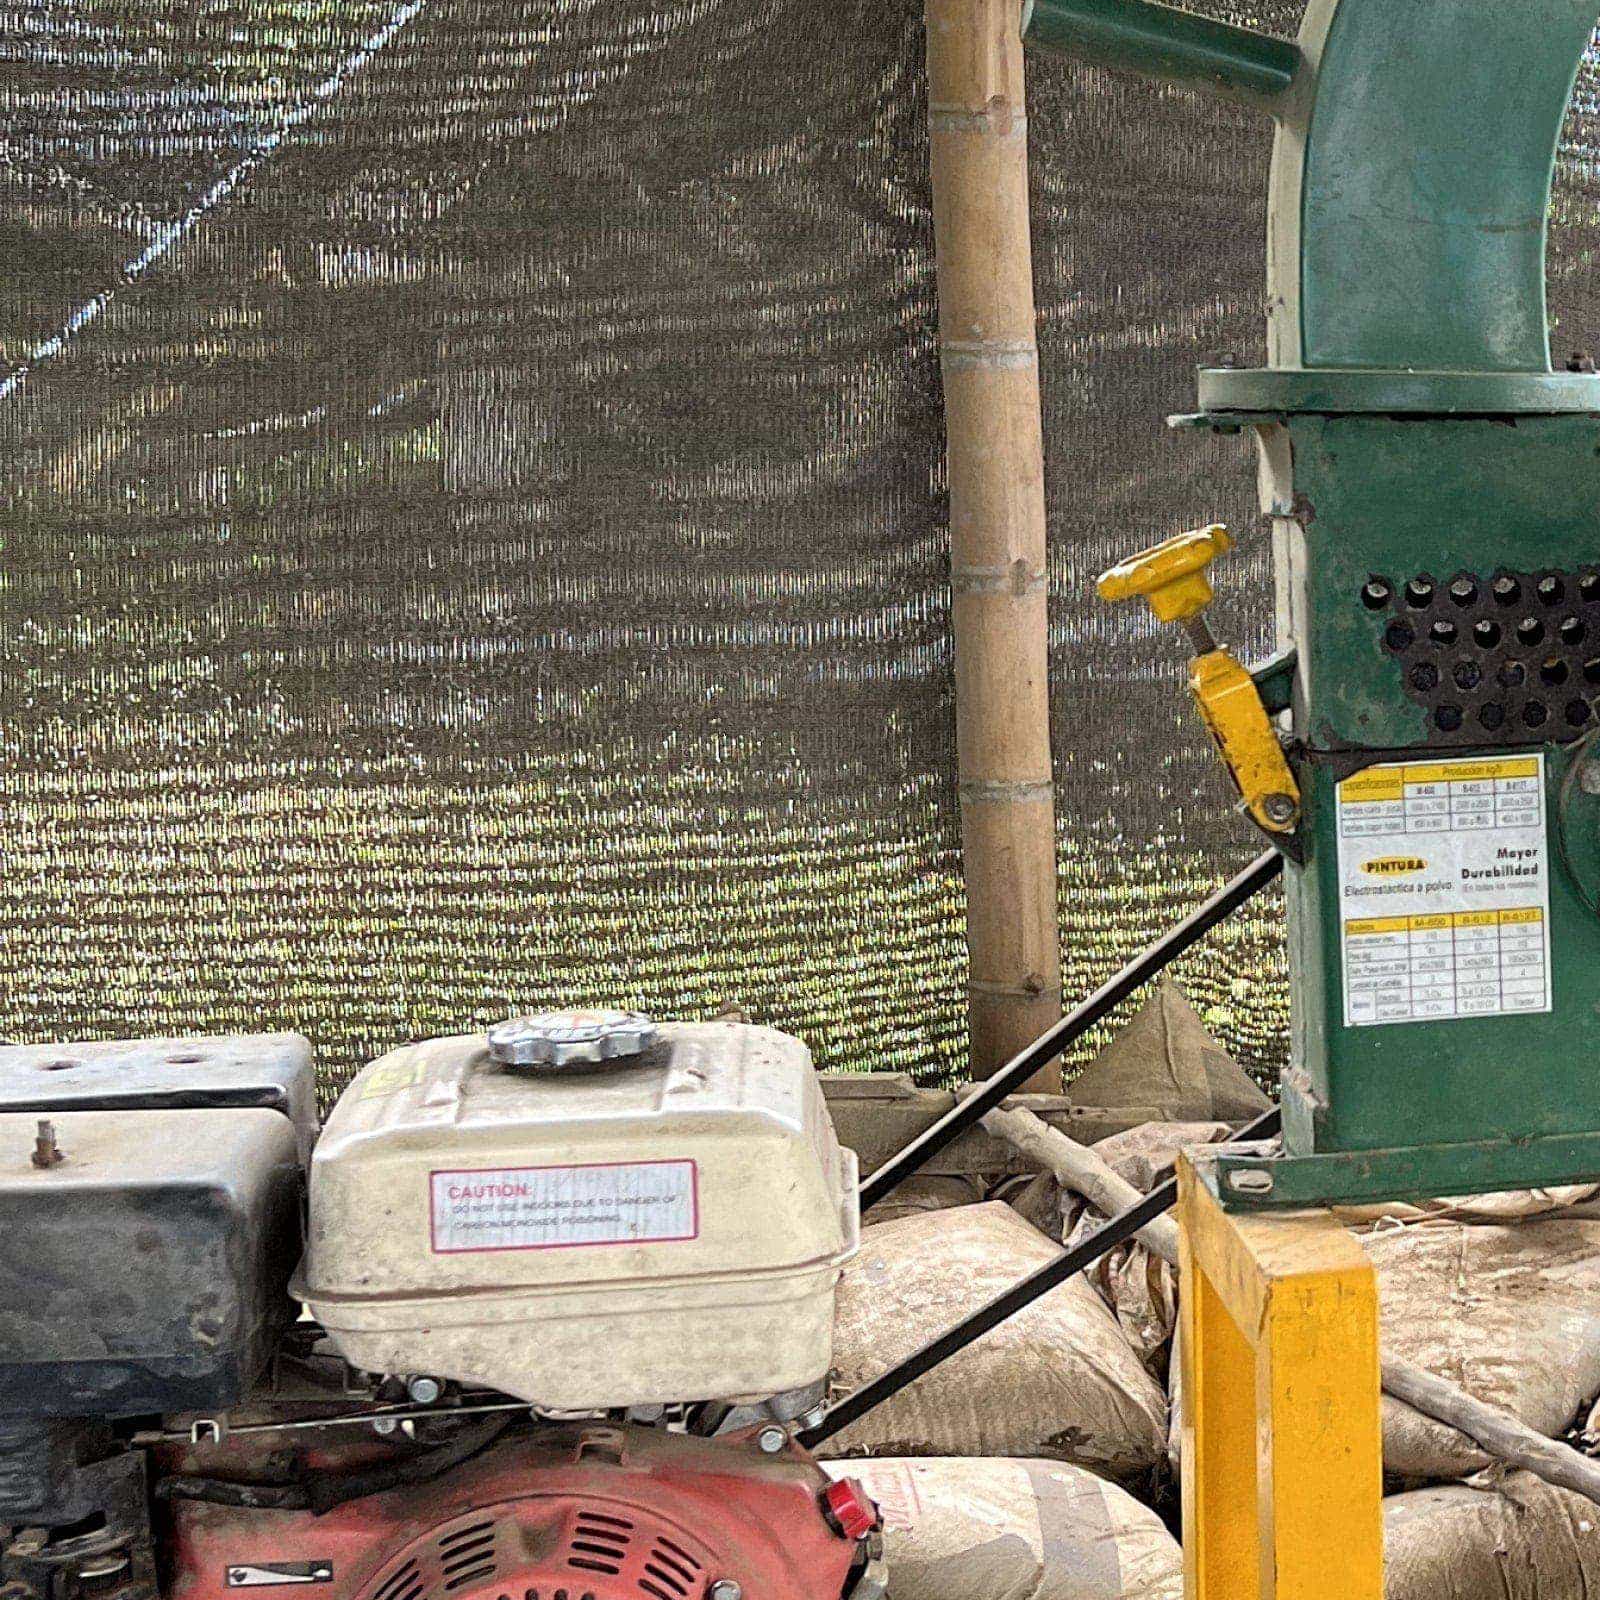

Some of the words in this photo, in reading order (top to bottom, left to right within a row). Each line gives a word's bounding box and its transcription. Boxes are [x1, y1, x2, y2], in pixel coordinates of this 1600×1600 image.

[1497, 847, 1538, 860] Mayor
[1367, 860, 1425, 872] PINTURA
[1461, 864, 1538, 879] Durabilidad
